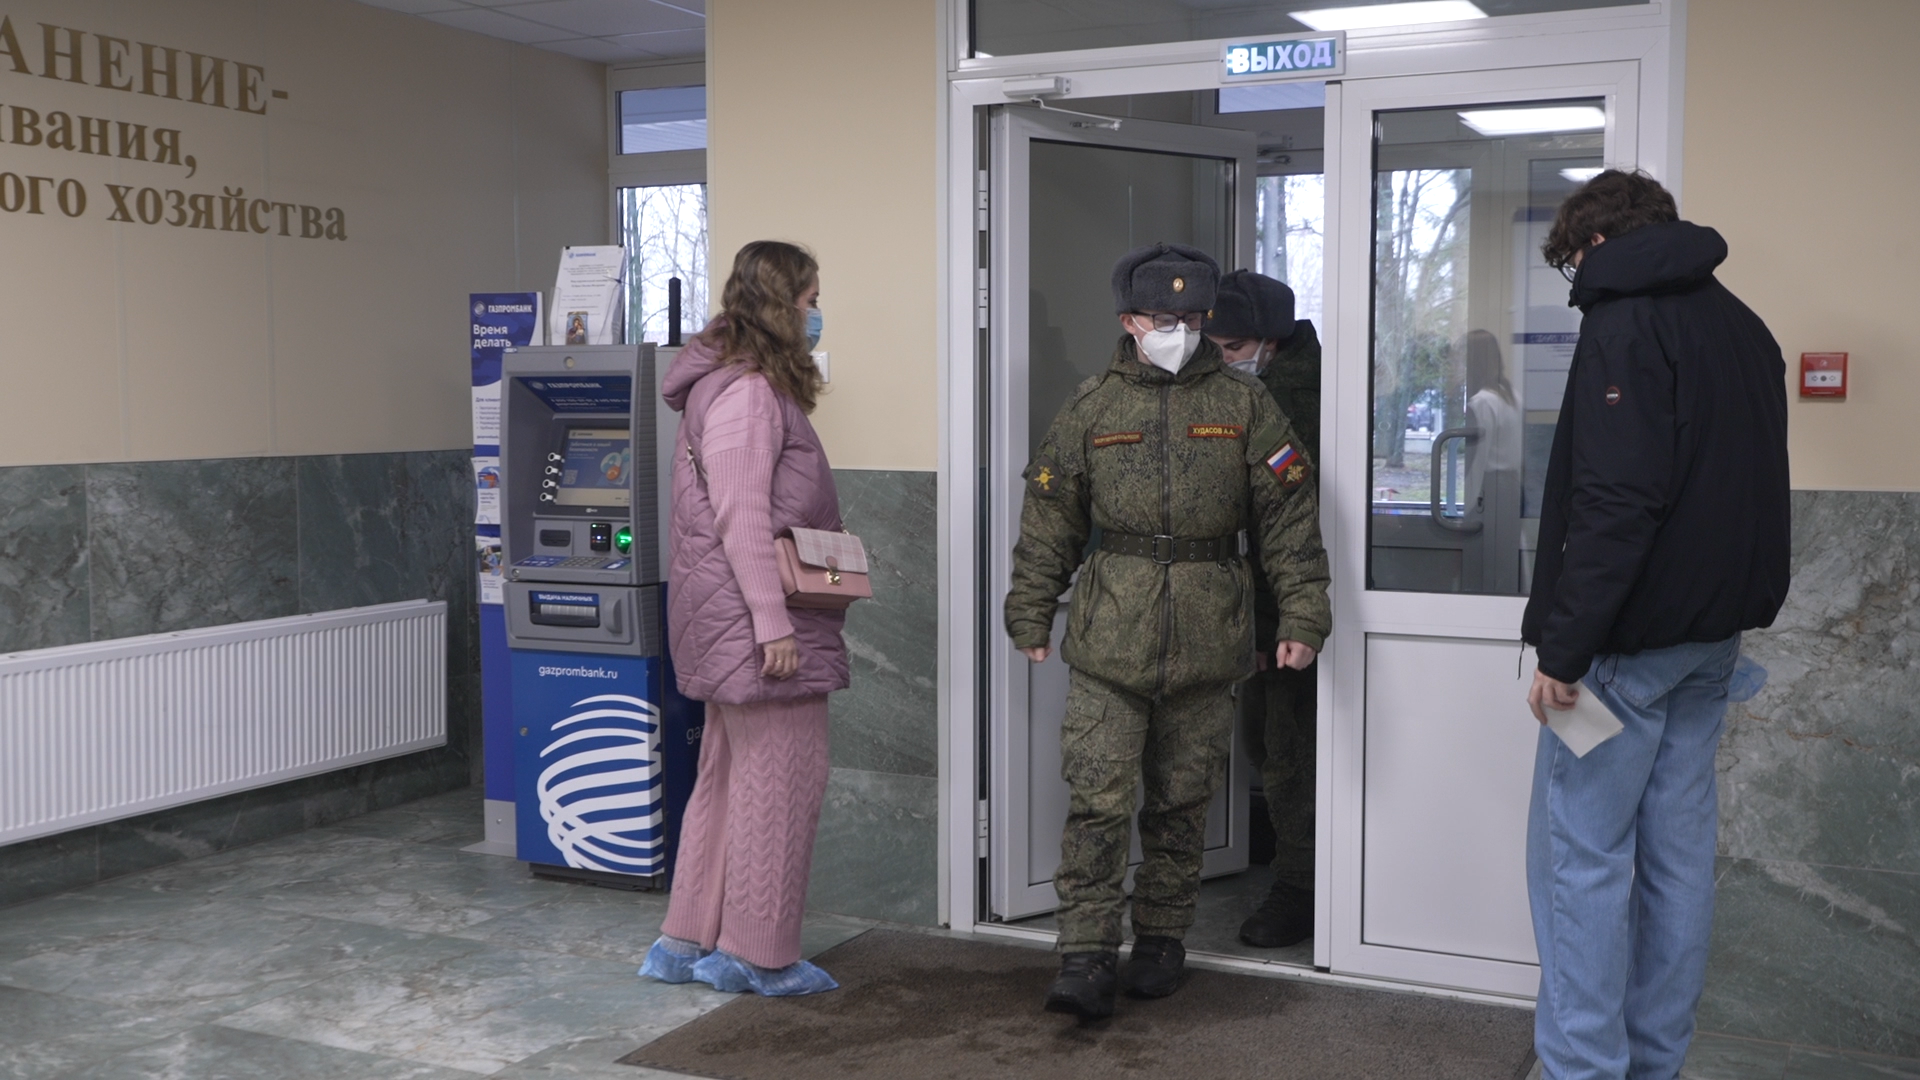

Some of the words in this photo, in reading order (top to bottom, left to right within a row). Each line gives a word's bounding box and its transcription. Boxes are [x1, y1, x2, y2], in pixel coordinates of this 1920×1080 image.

[1231, 41, 1332, 74] ВЫХОД
[0, 104, 197, 179] вания,
[104, 183, 348, 242] хозяйства
[488, 304, 533, 313] ГАЗПРОМБАНК
[473, 324, 508, 337] Время
[473, 338, 512, 349] делать
[538, 665, 618, 680] gazprombank.ru
